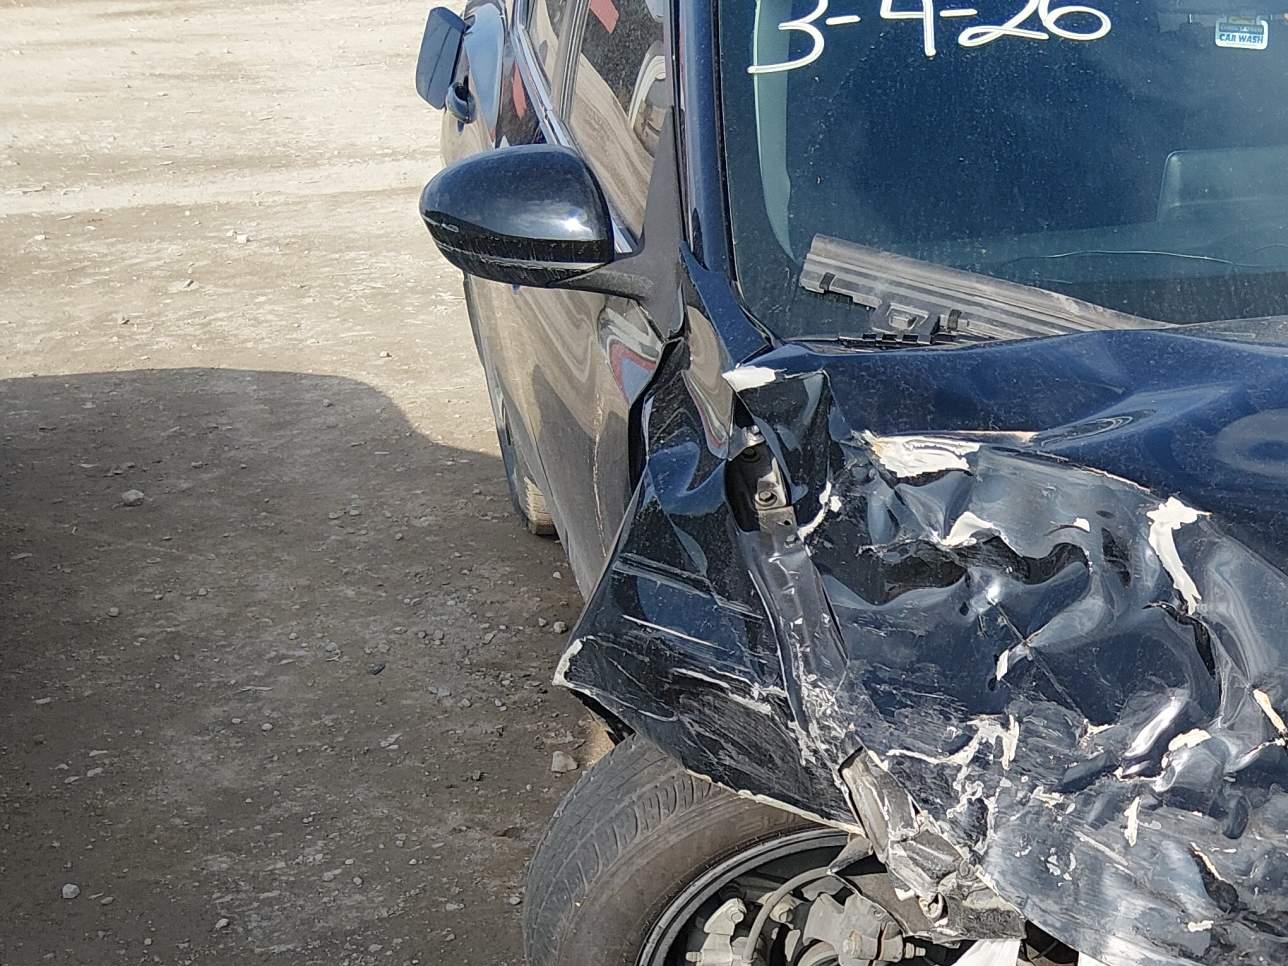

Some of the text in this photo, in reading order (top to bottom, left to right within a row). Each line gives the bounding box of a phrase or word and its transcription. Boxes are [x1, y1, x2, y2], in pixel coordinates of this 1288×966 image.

[747, 0, 1112, 74] 3-4-26
[1219, 33, 1264, 44] CAR WASH
